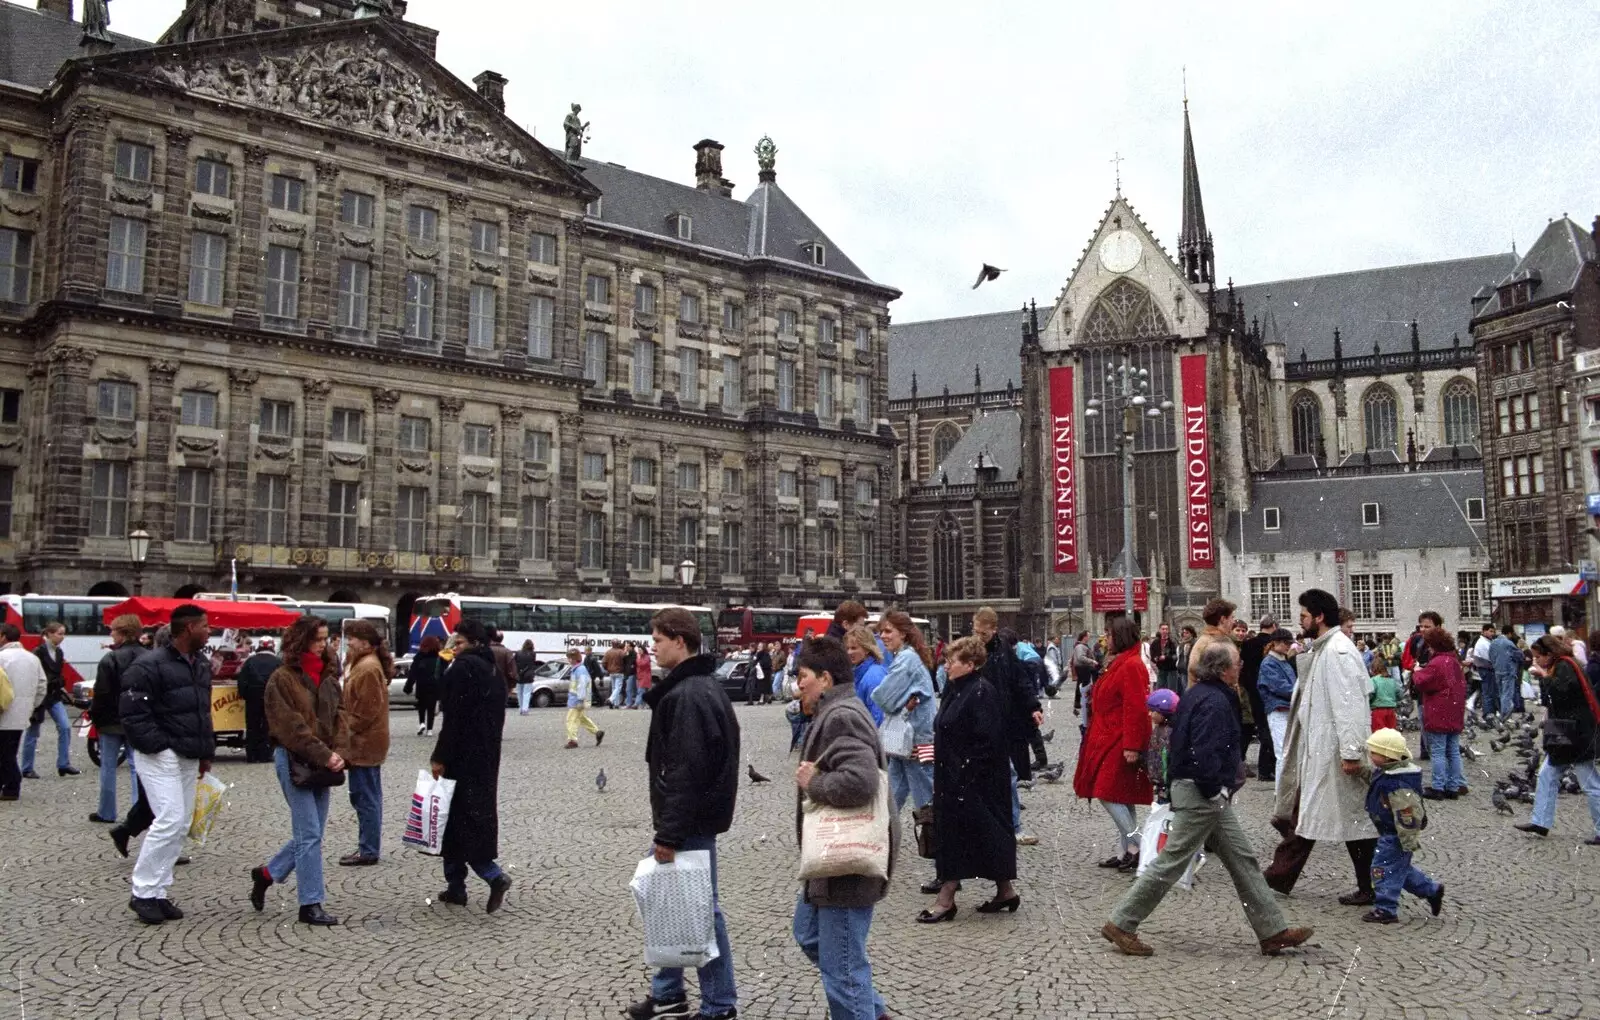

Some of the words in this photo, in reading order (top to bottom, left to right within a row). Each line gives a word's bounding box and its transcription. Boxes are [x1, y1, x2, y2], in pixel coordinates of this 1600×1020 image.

[1055, 414, 1074, 565] INDONESIA
[1187, 405, 1210, 561] INDONESIE
[1512, 585, 1551, 594] Excursions
[430, 805, 440, 848] drugstore
